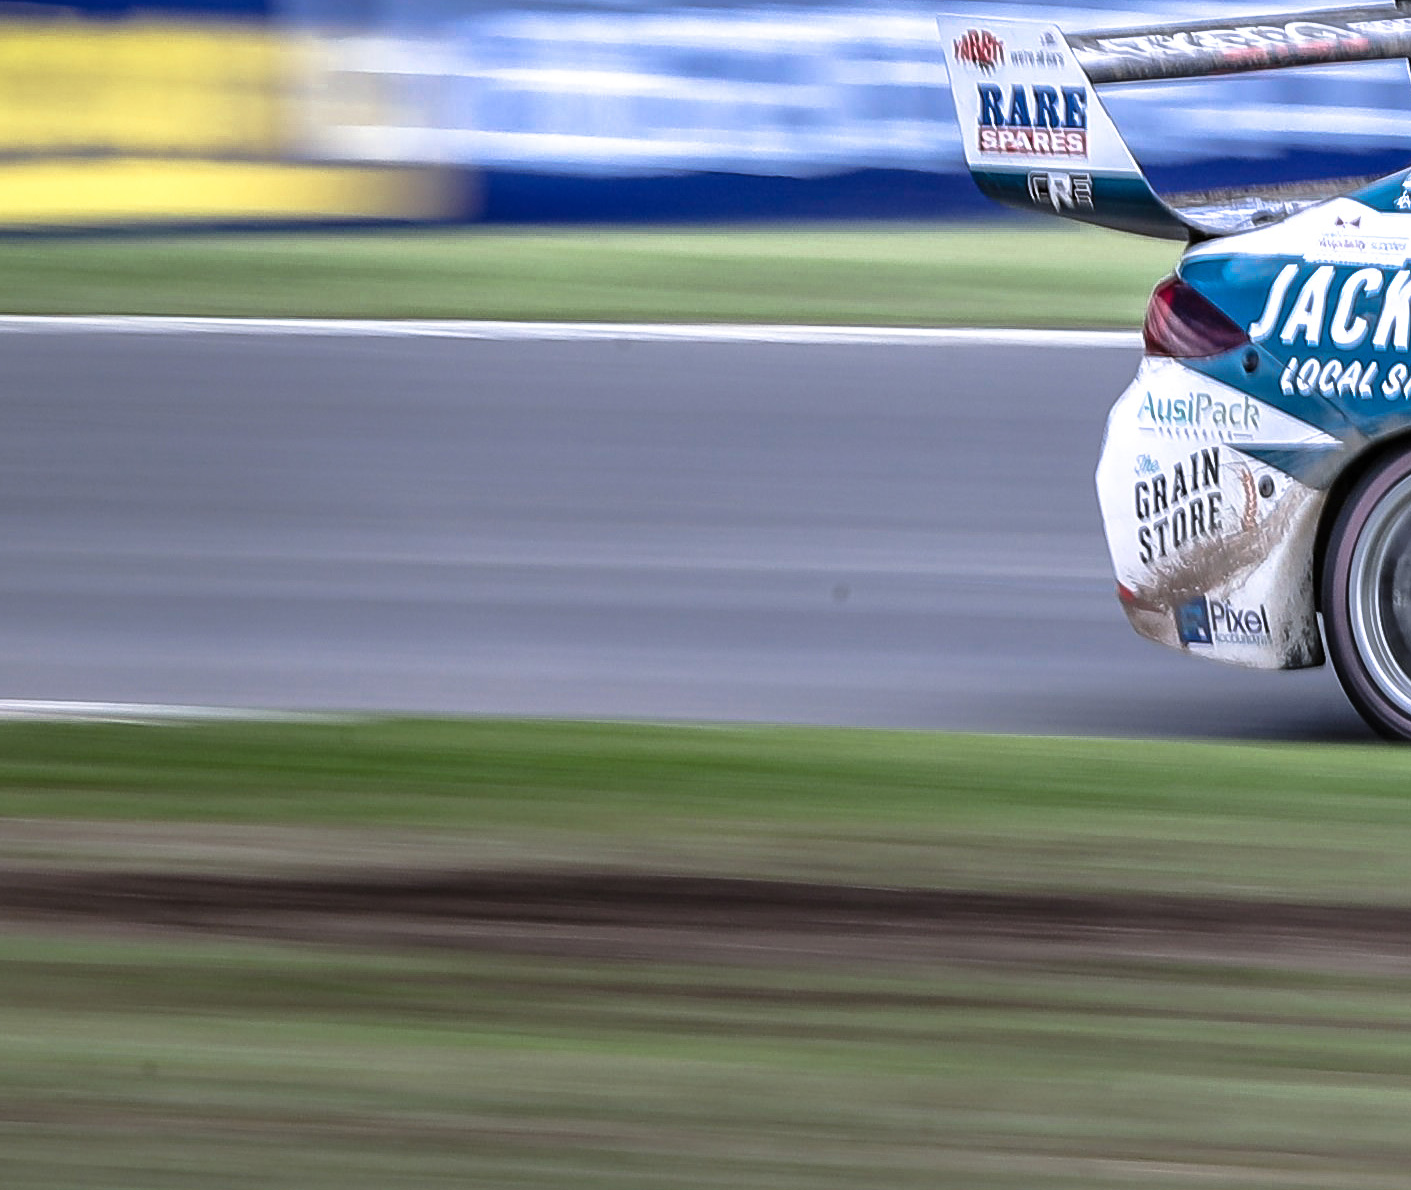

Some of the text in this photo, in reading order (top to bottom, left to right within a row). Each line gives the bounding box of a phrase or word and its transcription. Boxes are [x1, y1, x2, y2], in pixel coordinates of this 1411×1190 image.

[977, 82, 1088, 129] RARE
[981, 129, 1084, 153] SPARES
[1279, 357, 1374, 398] LOCAL
[1137, 390, 1261, 431] AusiPack
[1134, 446, 1221, 522] GRAIN
[1136, 491, 1223, 566] STORE
[1210, 600, 1271, 639] Pixel
